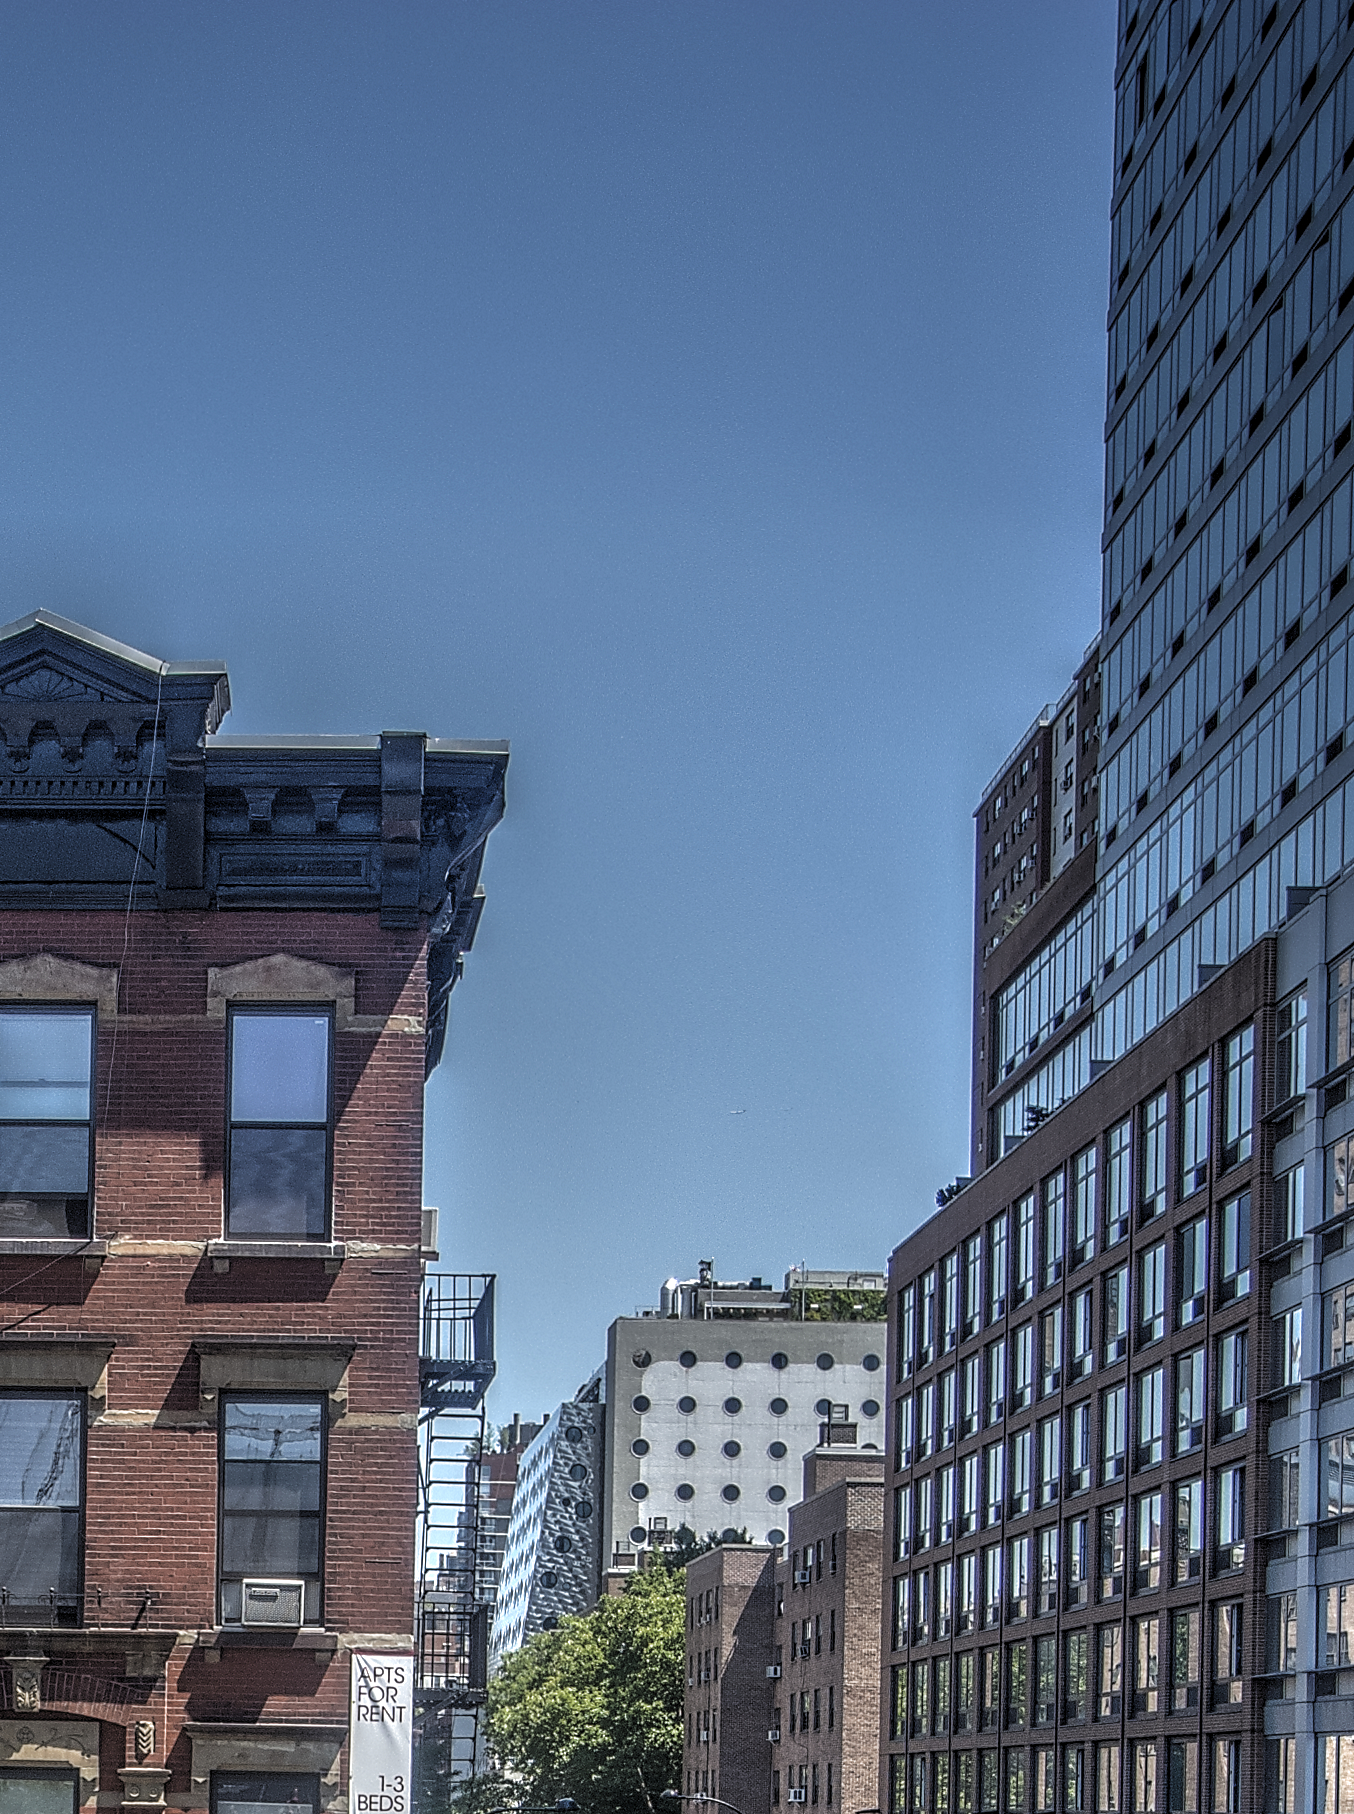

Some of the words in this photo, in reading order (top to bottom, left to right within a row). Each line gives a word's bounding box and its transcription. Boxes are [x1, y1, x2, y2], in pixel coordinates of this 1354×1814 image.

[357, 1666, 405, 1684] APTS
[358, 1685, 398, 1703] FOR
[357, 1704, 407, 1723] RENT
[378, 1775, 405, 1793] 1-3
[358, 1794, 405, 1812] BEDS
